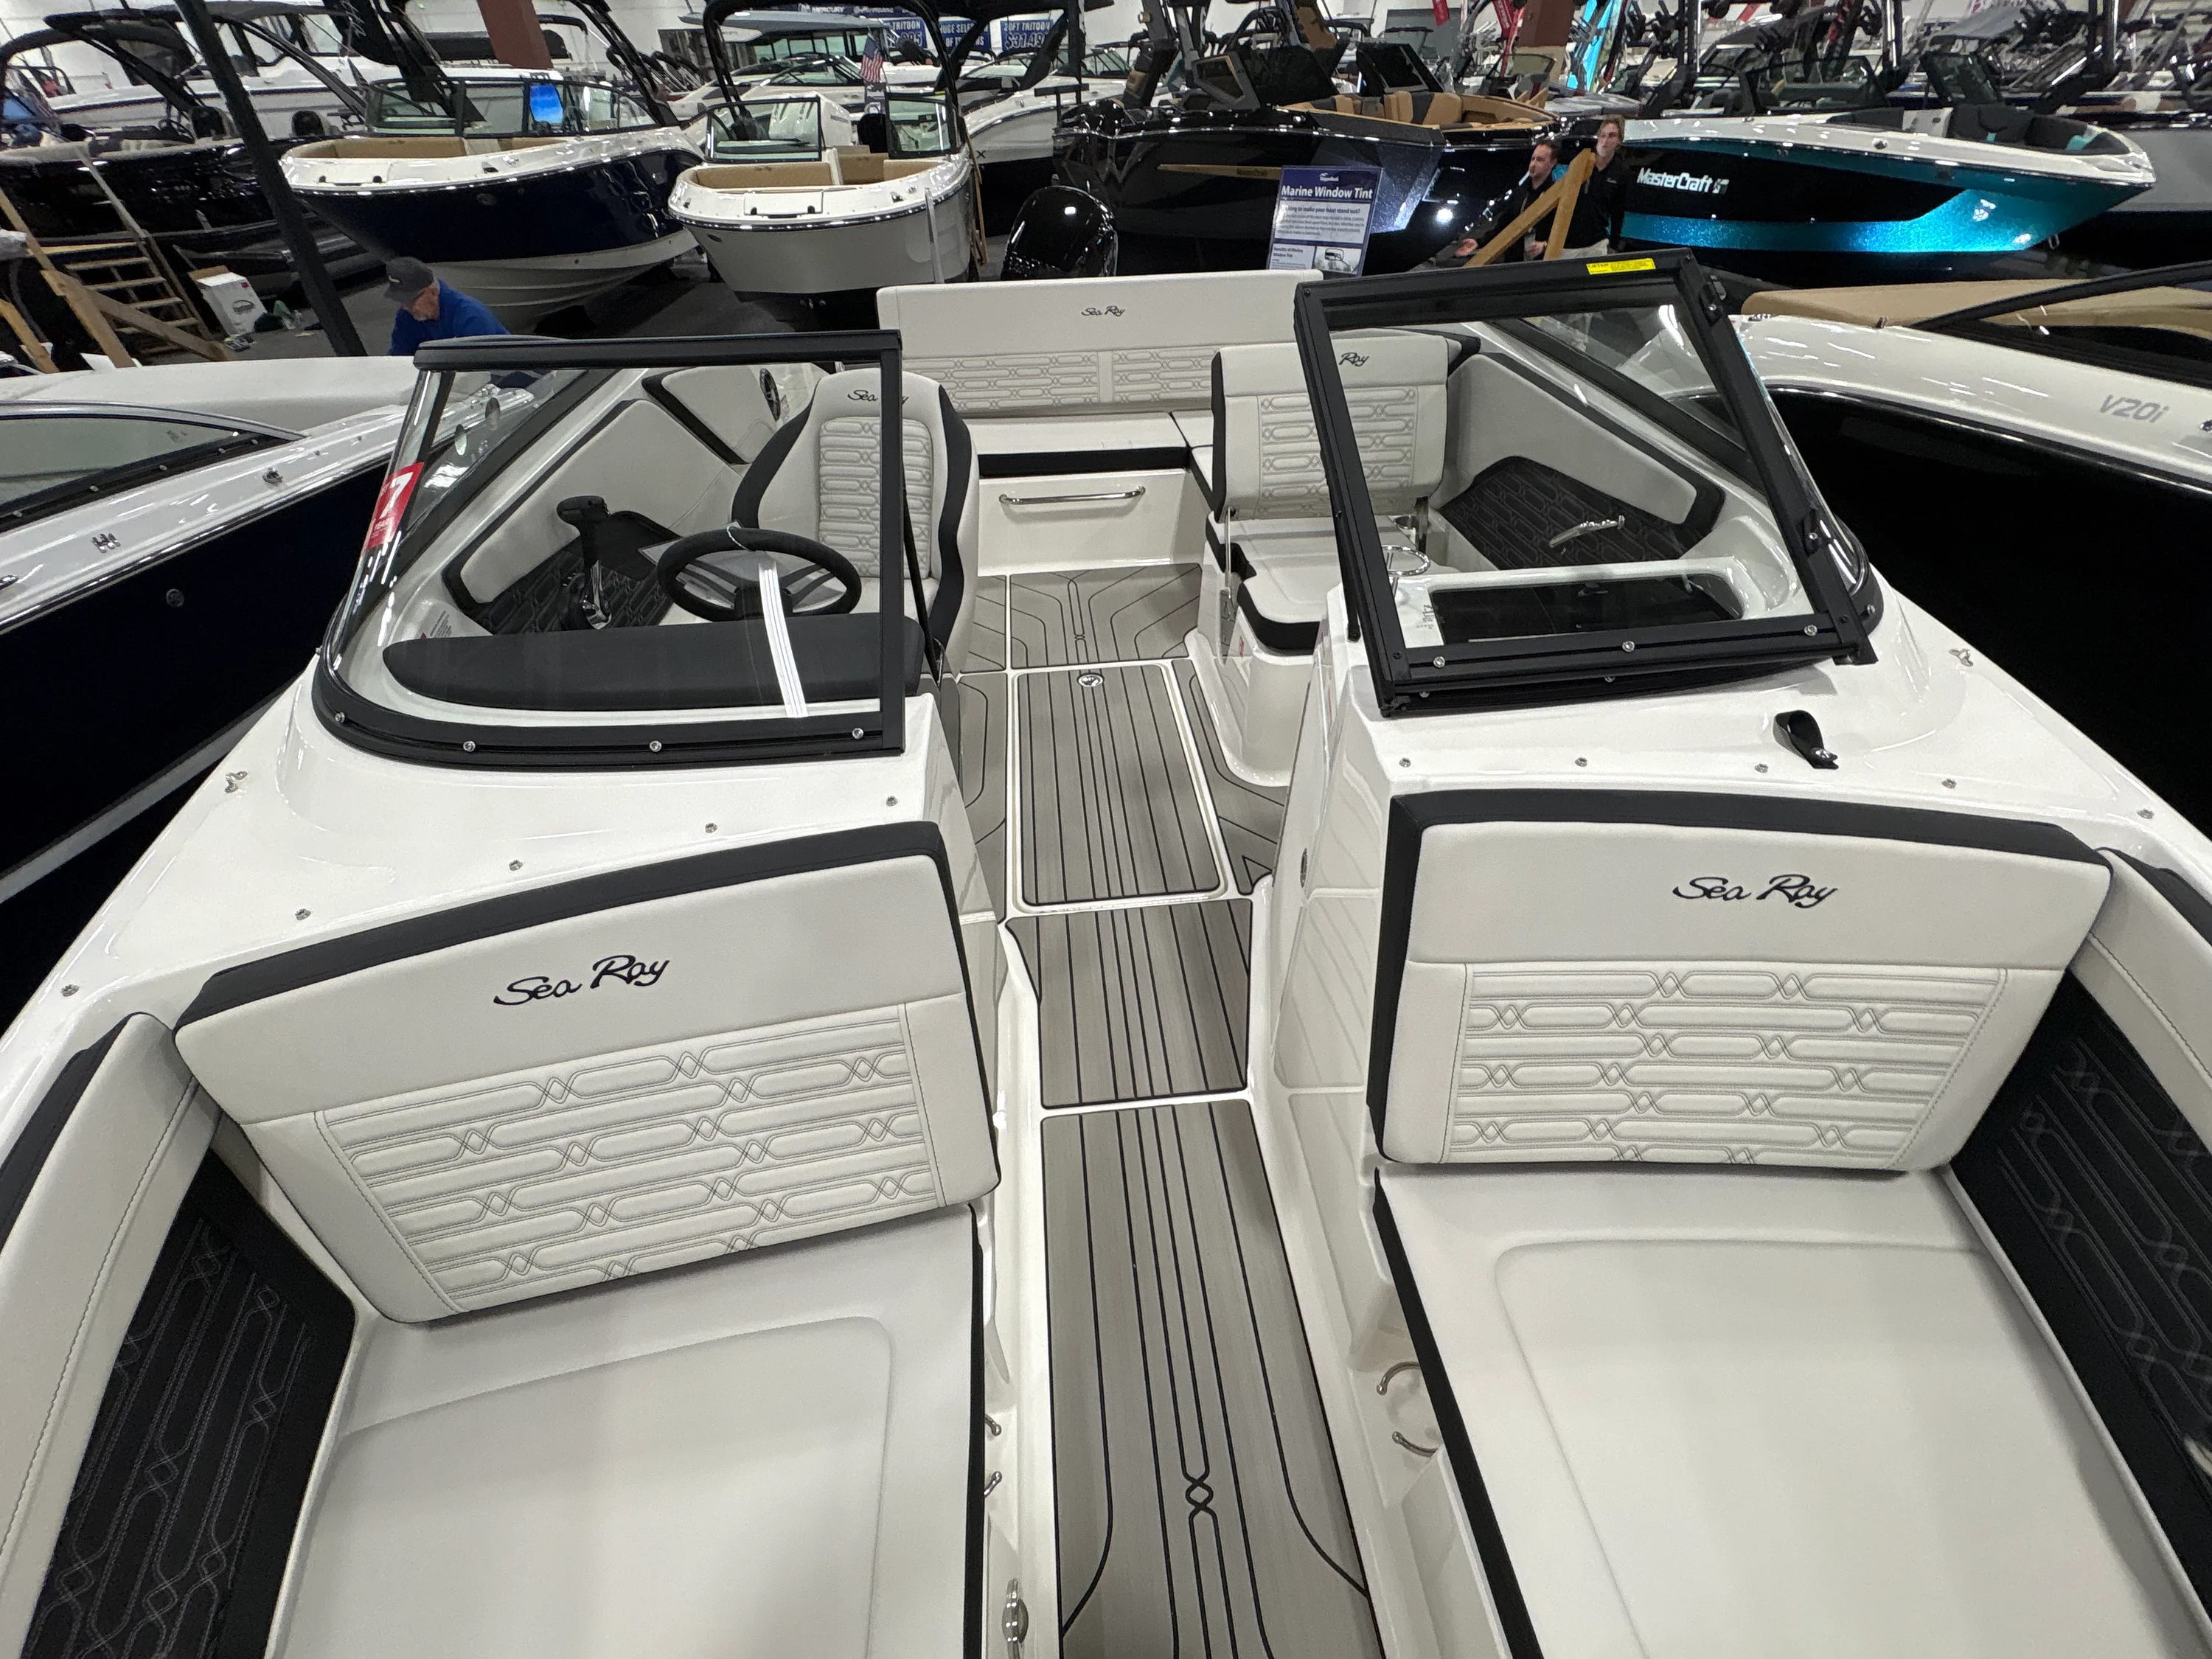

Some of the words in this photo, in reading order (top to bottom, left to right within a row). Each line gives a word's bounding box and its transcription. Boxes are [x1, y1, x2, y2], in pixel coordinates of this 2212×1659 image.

[892, 21, 921, 30] TRITOON
[1022, 21, 1050, 31] TRITOON
[945, 37, 954, 47] OF
[1636, 167, 1714, 193] MasterCraft
[1281, 184, 1313, 197] Marine
[1315, 186, 1352, 198] Window
[1354, 187, 1373, 199] Tint
[1081, 307, 1103, 316] Sea
[1104, 305, 1125, 317] Ray
[1338, 352, 1370, 367] Ray
[847, 389, 878, 402] Sea
[2099, 394, 2170, 423] V20i
[1672, 876, 1752, 901] Sea
[1756, 874, 1838, 908] Ray
[493, 975, 582, 1006] Sea
[590, 954, 670, 989] Ray
